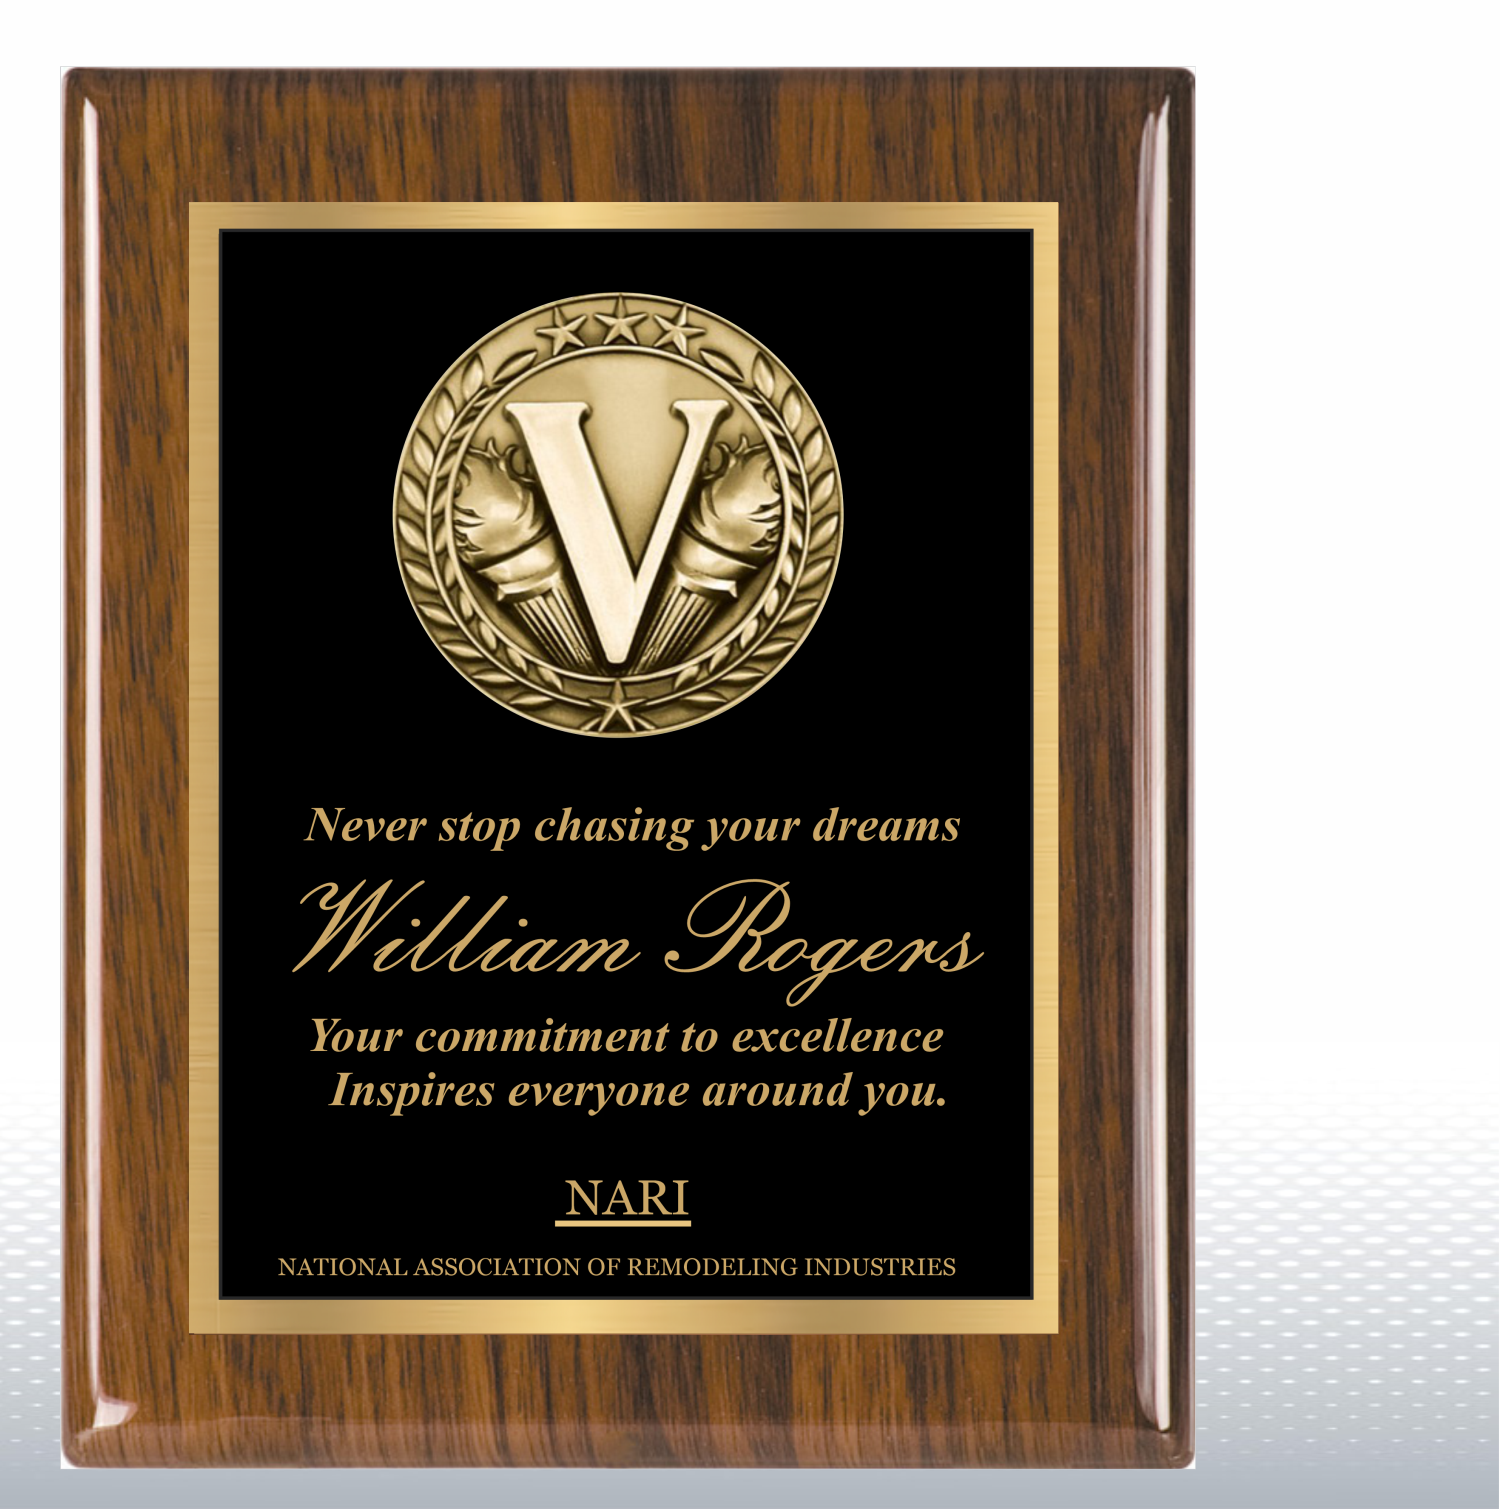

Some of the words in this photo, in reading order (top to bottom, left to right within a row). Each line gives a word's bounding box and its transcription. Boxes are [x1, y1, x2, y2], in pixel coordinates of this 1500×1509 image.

[504, 399, 733, 664] V
[303, 807, 428, 842] Never
[438, 811, 521, 852] stop
[534, 806, 695, 852] chasing
[700, 817, 801, 852] your
[812, 806, 961, 842] dreams
[291, 878, 642, 973] William
[664, 878, 985, 1008] Rogers
[309, 1018, 404, 1053] Your
[415, 1017, 671, 1053] commitment
[680, 1022, 719, 1053] to
[731, 1017, 944, 1053] excellence
[327, 1071, 495, 1117] Inspires
[508, 1082, 690, 1117] everyone
[702, 1071, 854, 1107] around
[857, 1082, 946, 1117] you.
[564, 1179, 689, 1216] NARI
[277, 1257, 408, 1277] NATIONAL
[412, 1257, 581, 1277] ASSOCIATION
[587, 1257, 621, 1277] OF
[627, 1257, 798, 1277] REMODELING
[804, 1257, 956, 1277] INDUSTRIES
